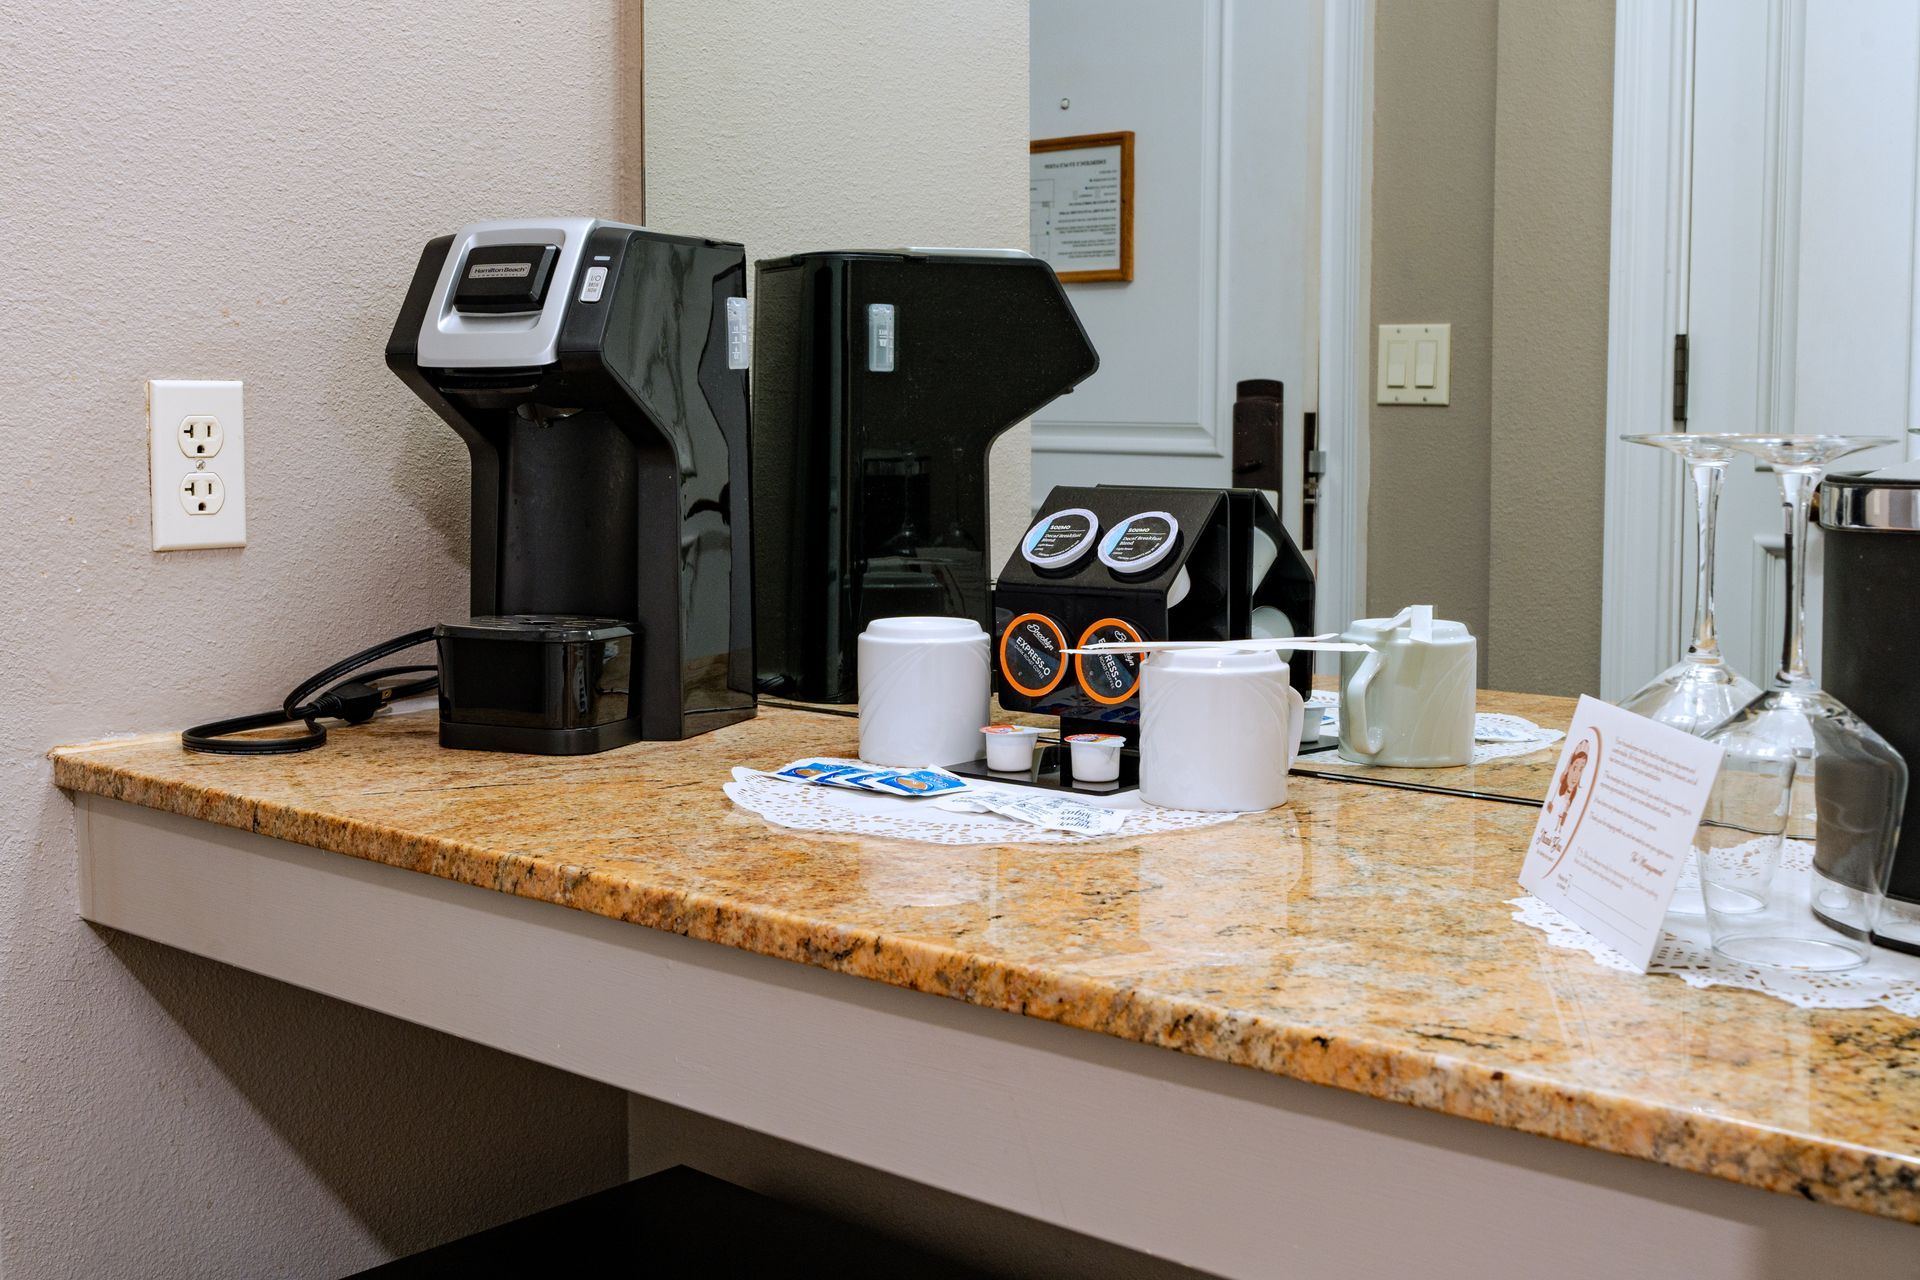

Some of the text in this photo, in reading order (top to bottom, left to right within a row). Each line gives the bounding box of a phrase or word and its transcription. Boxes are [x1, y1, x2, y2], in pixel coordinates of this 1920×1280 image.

[1016, 636, 1050, 676] EXPRESS-O
[1027, 624, 1054, 651] Brooklyn
[1098, 637, 1123, 688] ERESS-O
